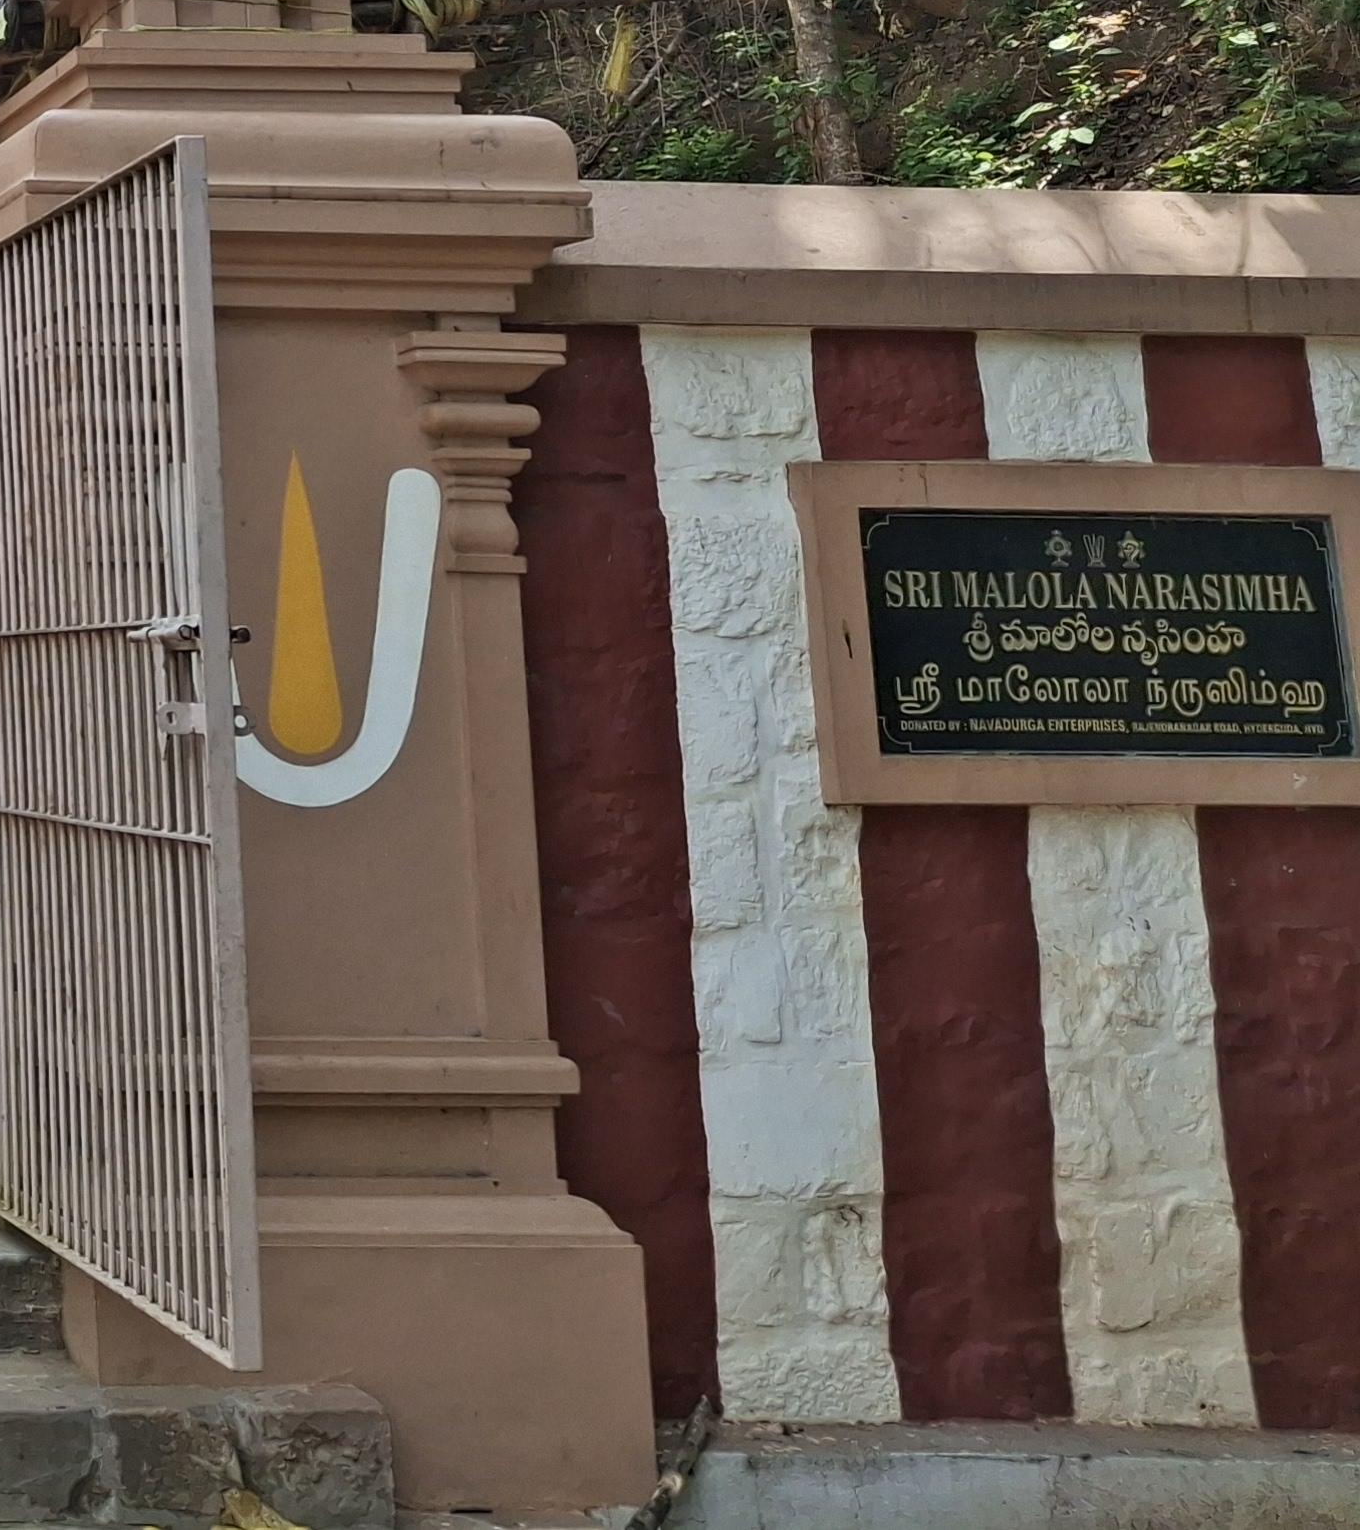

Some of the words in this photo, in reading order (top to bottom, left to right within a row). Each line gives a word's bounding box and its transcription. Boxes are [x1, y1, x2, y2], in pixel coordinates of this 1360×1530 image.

[884, 570, 943, 608] SRI
[951, 571, 1098, 610] MALOLA
[1103, 573, 1318, 612] NARASIMHA
[957, 664, 1130, 703] மாலோலா
[900, 719, 947, 732] DONATED
[969, 718, 1046, 732] NAVADURGA
[1048, 718, 1130, 734] ENTERPRISES,
